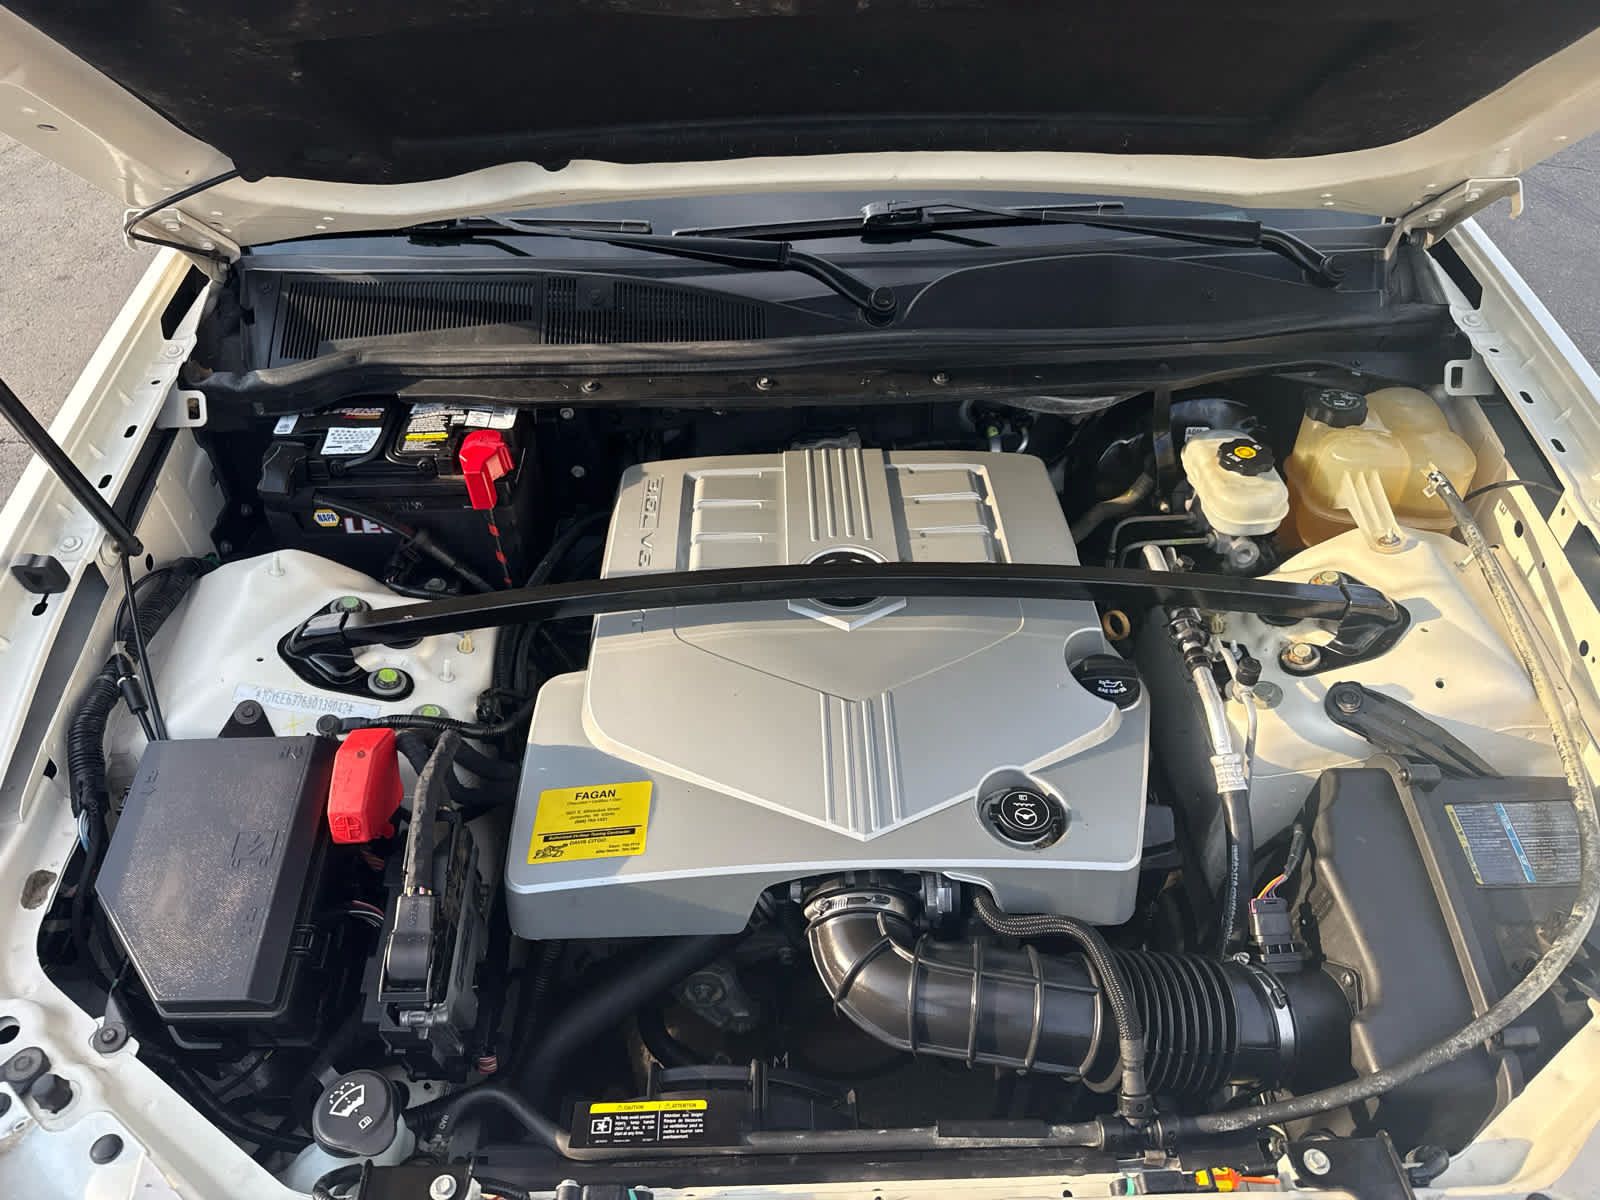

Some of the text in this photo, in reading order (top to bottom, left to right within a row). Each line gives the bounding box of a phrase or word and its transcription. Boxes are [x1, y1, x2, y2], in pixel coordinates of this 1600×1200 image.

[316, 513, 337, 522] NAPA
[638, 532, 656, 567] V6
[575, 789, 617, 801] FAGAN
